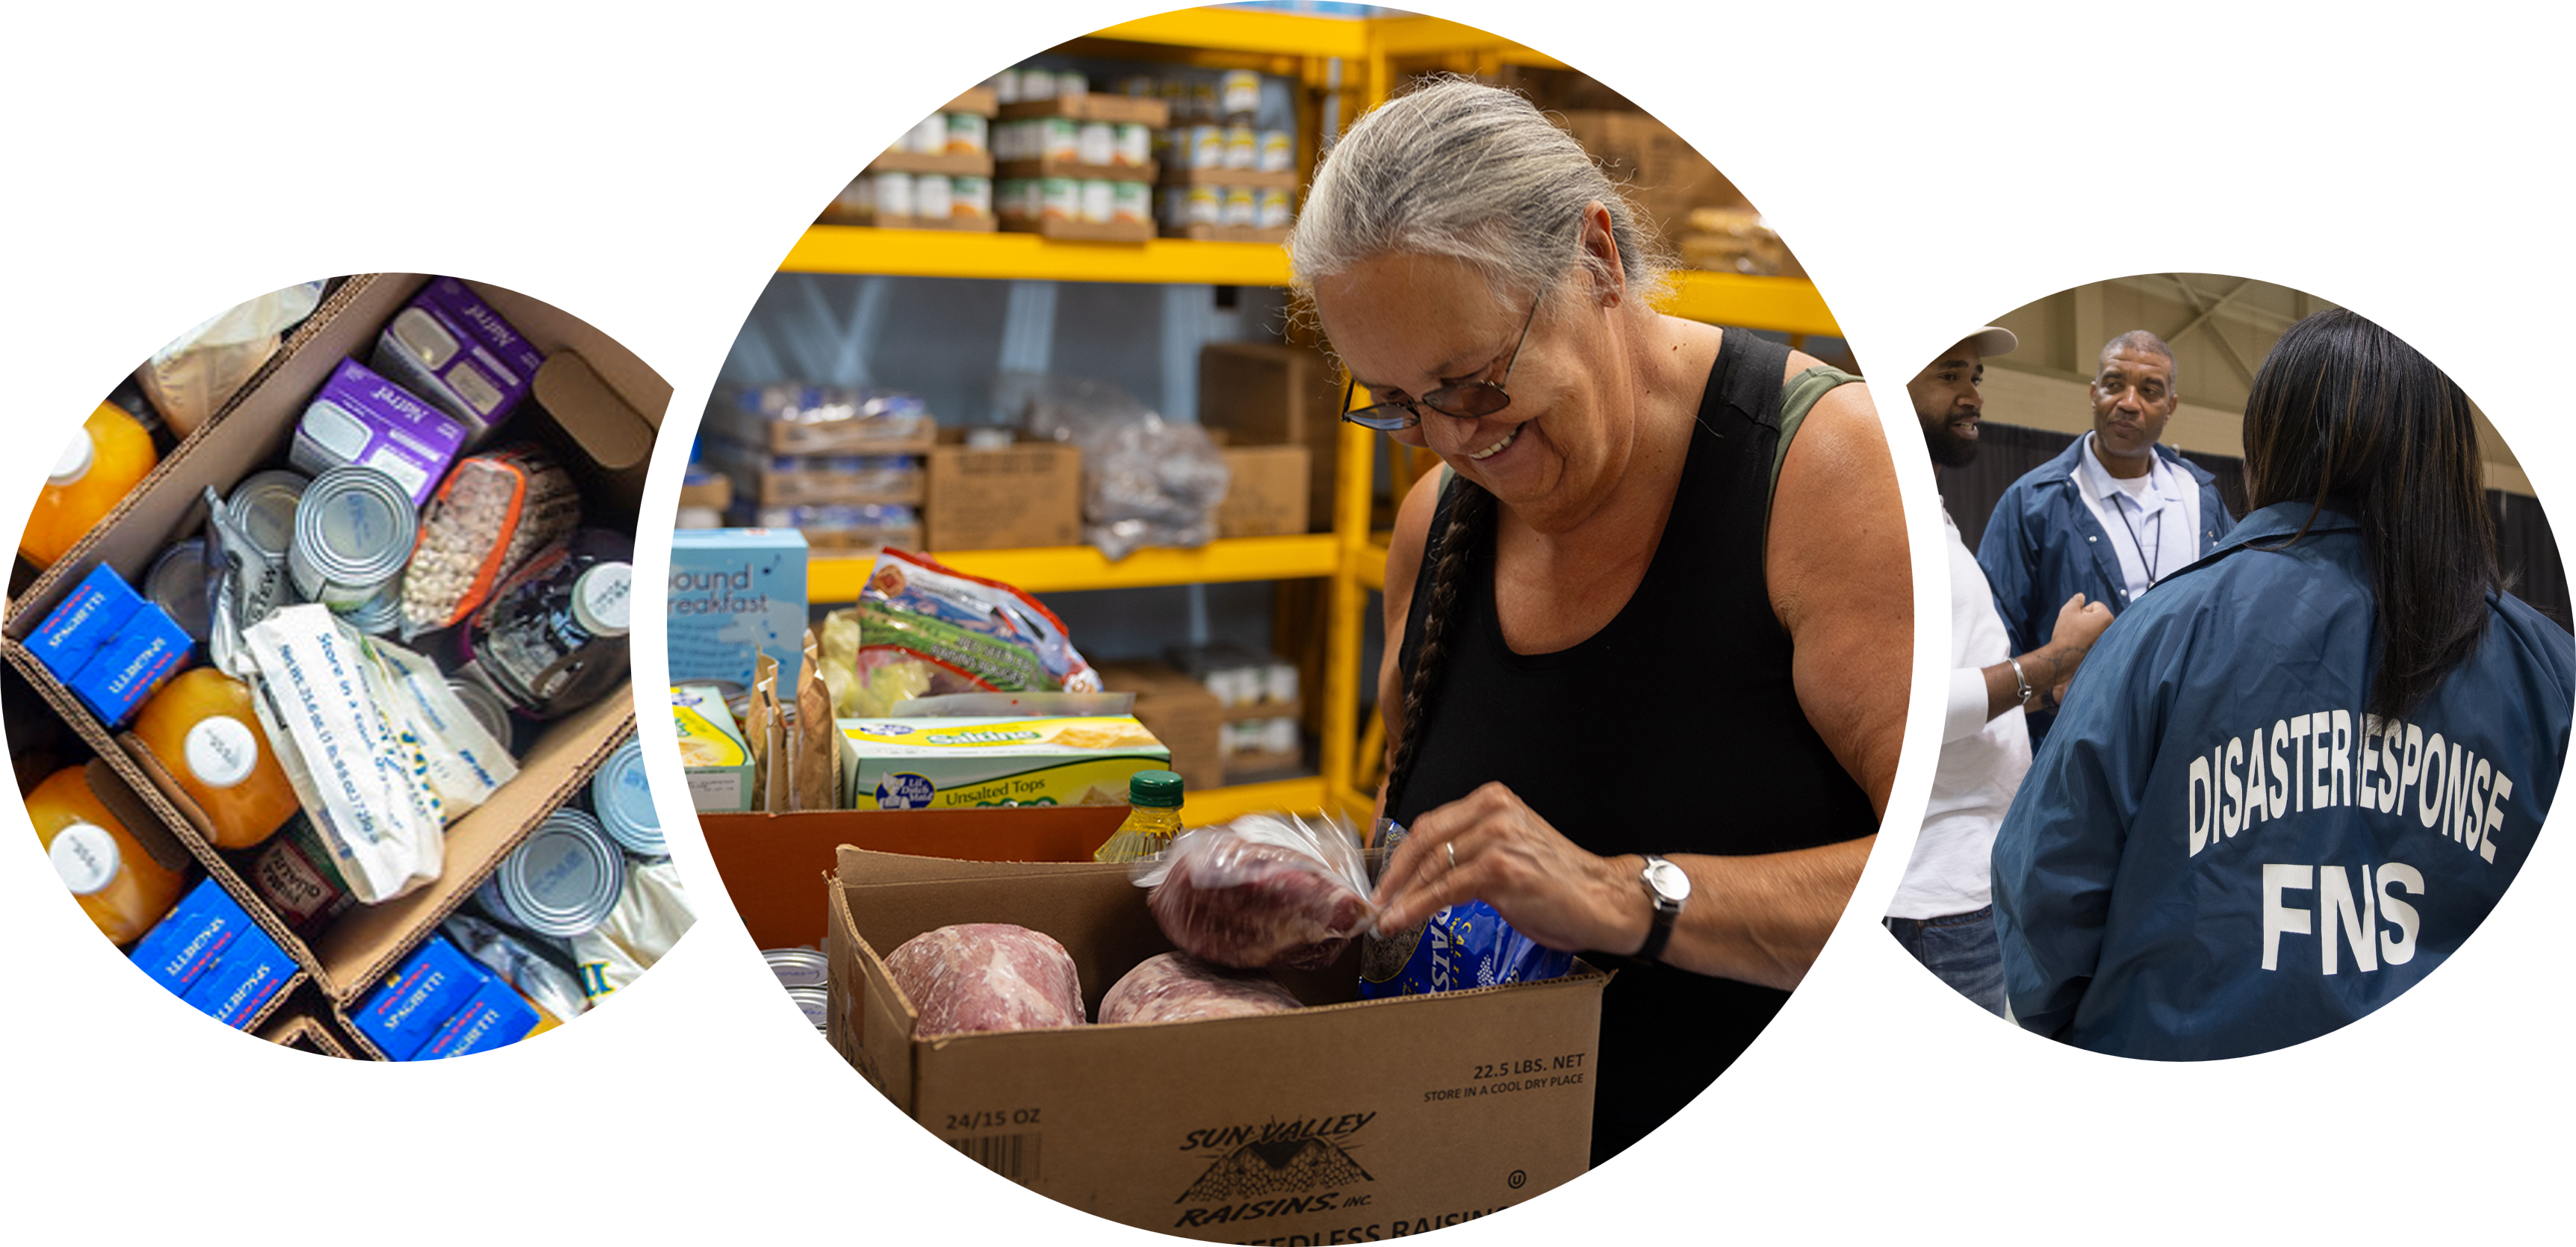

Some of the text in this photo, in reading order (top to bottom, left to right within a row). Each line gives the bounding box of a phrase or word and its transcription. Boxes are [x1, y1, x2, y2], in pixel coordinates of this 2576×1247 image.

[46, 591, 106, 650] SPAGHETTI
[107, 635, 167, 695] SPAGHETTI
[317, 632, 344, 677] Store
[340, 680, 353, 697] in
[946, 785, 1008, 806] Unsalted
[1012, 779, 1045, 794] Tops
[2189, 709, 2513, 865] DISASTER ESPONSE
[164, 914, 226, 976] SPAGHETTI
[2262, 862, 2425, 975] FNS
[1428, 905, 1453, 995] RAIS
[383, 970, 445, 1032] SPAGHETTI
[443, 1007, 500, 1057] PAGHETTI
[1424, 1073, 1584, 1102] STORE IN A COOL DRY PLACE
[1474, 1054, 1585, 1080] 22.5 LBS. NET
[946, 1108, 1041, 1131] 24/15 OZ
[1179, 1111, 1377, 1151] SUN VALLEY
[1234, 1206, 1509, 1246] DLESS RAISI
